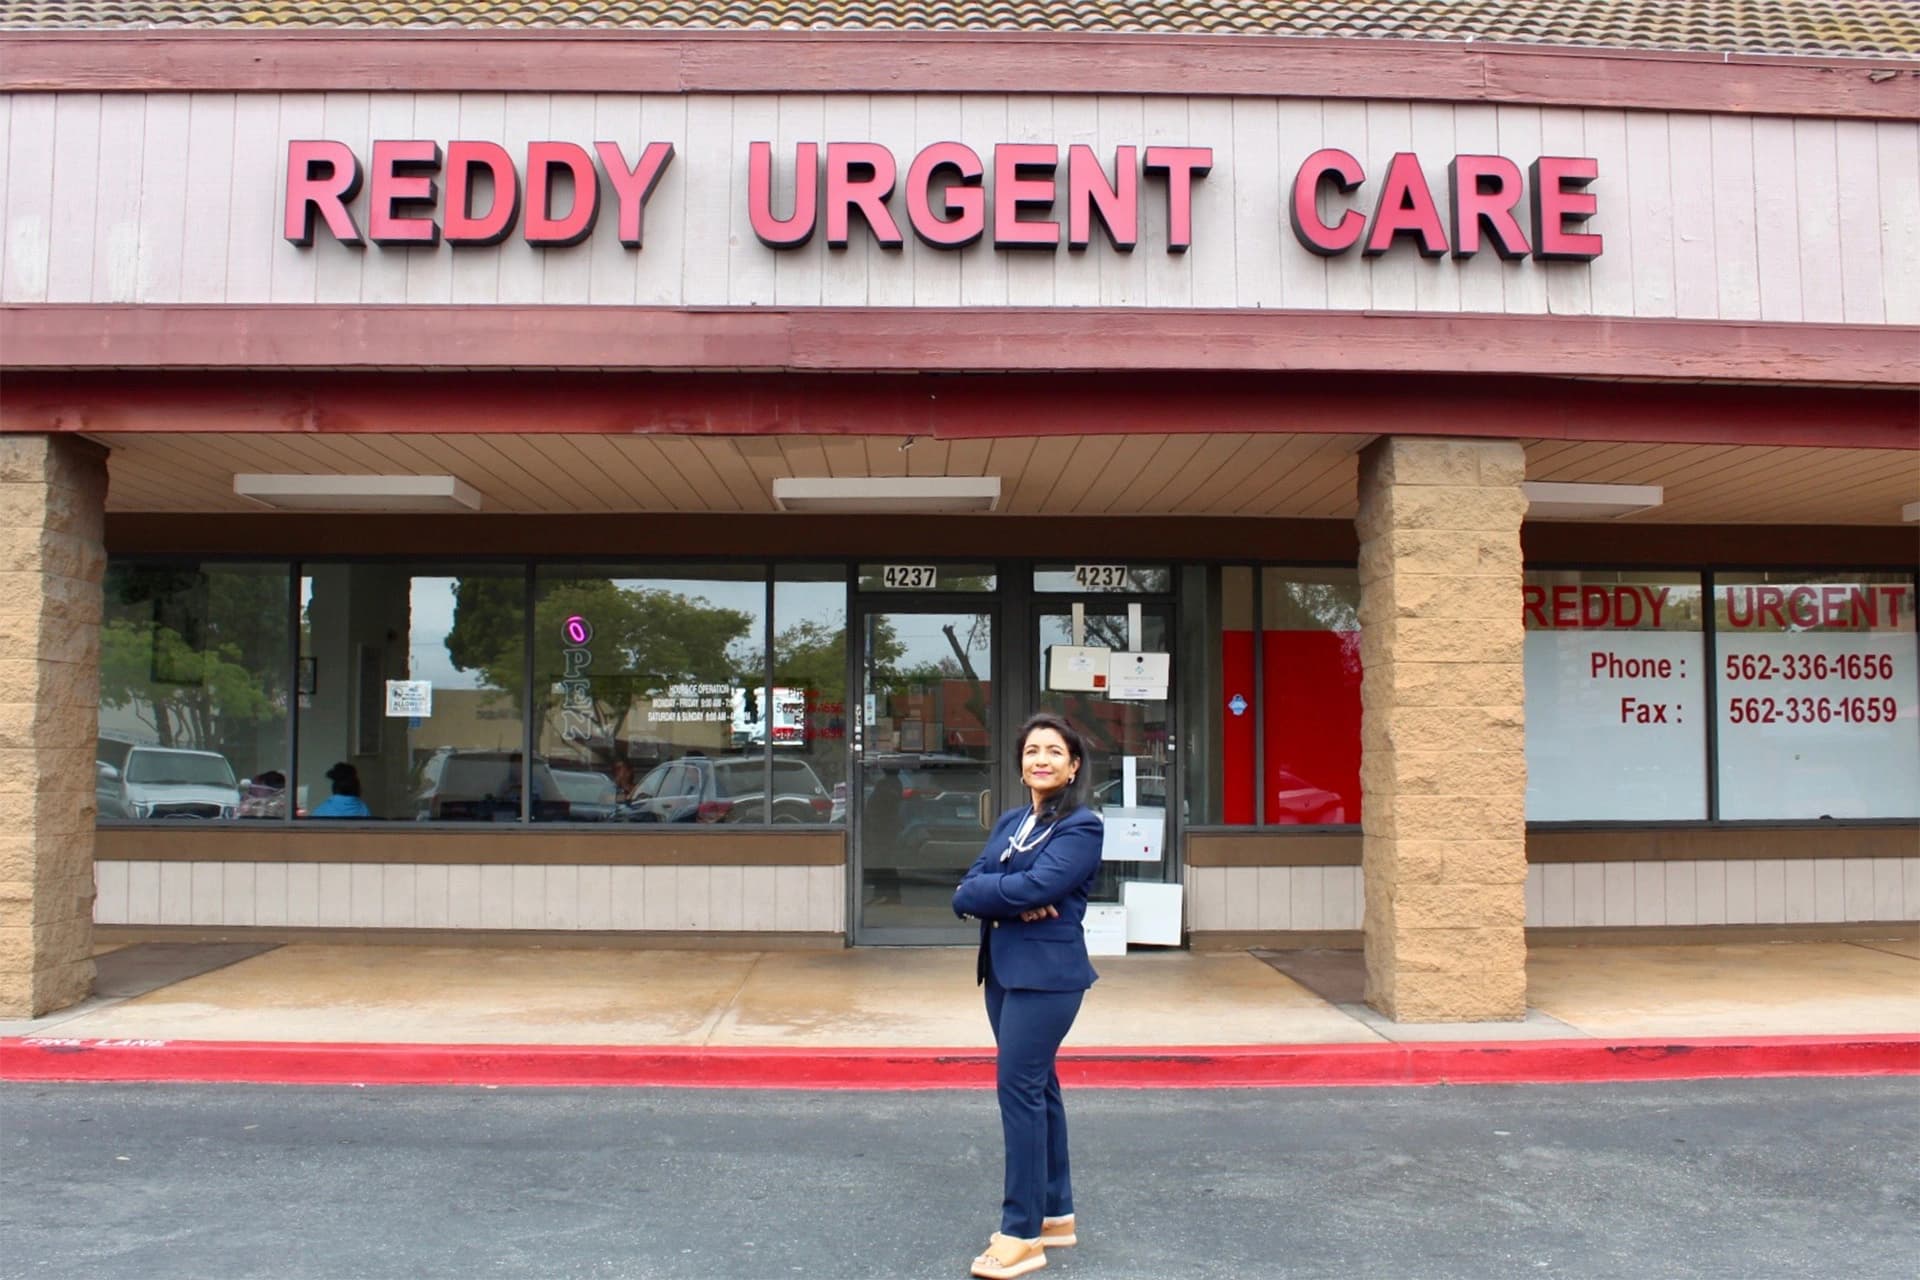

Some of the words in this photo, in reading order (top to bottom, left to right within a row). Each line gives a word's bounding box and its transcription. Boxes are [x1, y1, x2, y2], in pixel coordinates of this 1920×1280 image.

[284, 140, 675, 249] REDDY
[748, 141, 1213, 252] URGENT
[1289, 149, 1603, 262] CARE
[886, 567, 935, 587] 4237
[1076, 566, 1126, 587] 4237
[1522, 586, 1670, 628] REDDY
[1726, 586, 1906, 629] URGENT
[1591, 652, 1671, 679] Phone
[1726, 653, 1894, 681] 562-336-1656
[561, 616, 594, 741] OPEN
[698, 684, 729, 694] OPERATION
[680, 698, 698, 708] FRIDAY
[1621, 697, 1668, 724] Fax
[1729, 696, 1898, 724] 562-336-1659
[648, 711, 675, 721] SATURDAY
[682, 711, 704, 721] SUNDAY
[95, 1038, 163, 1047] LANE
